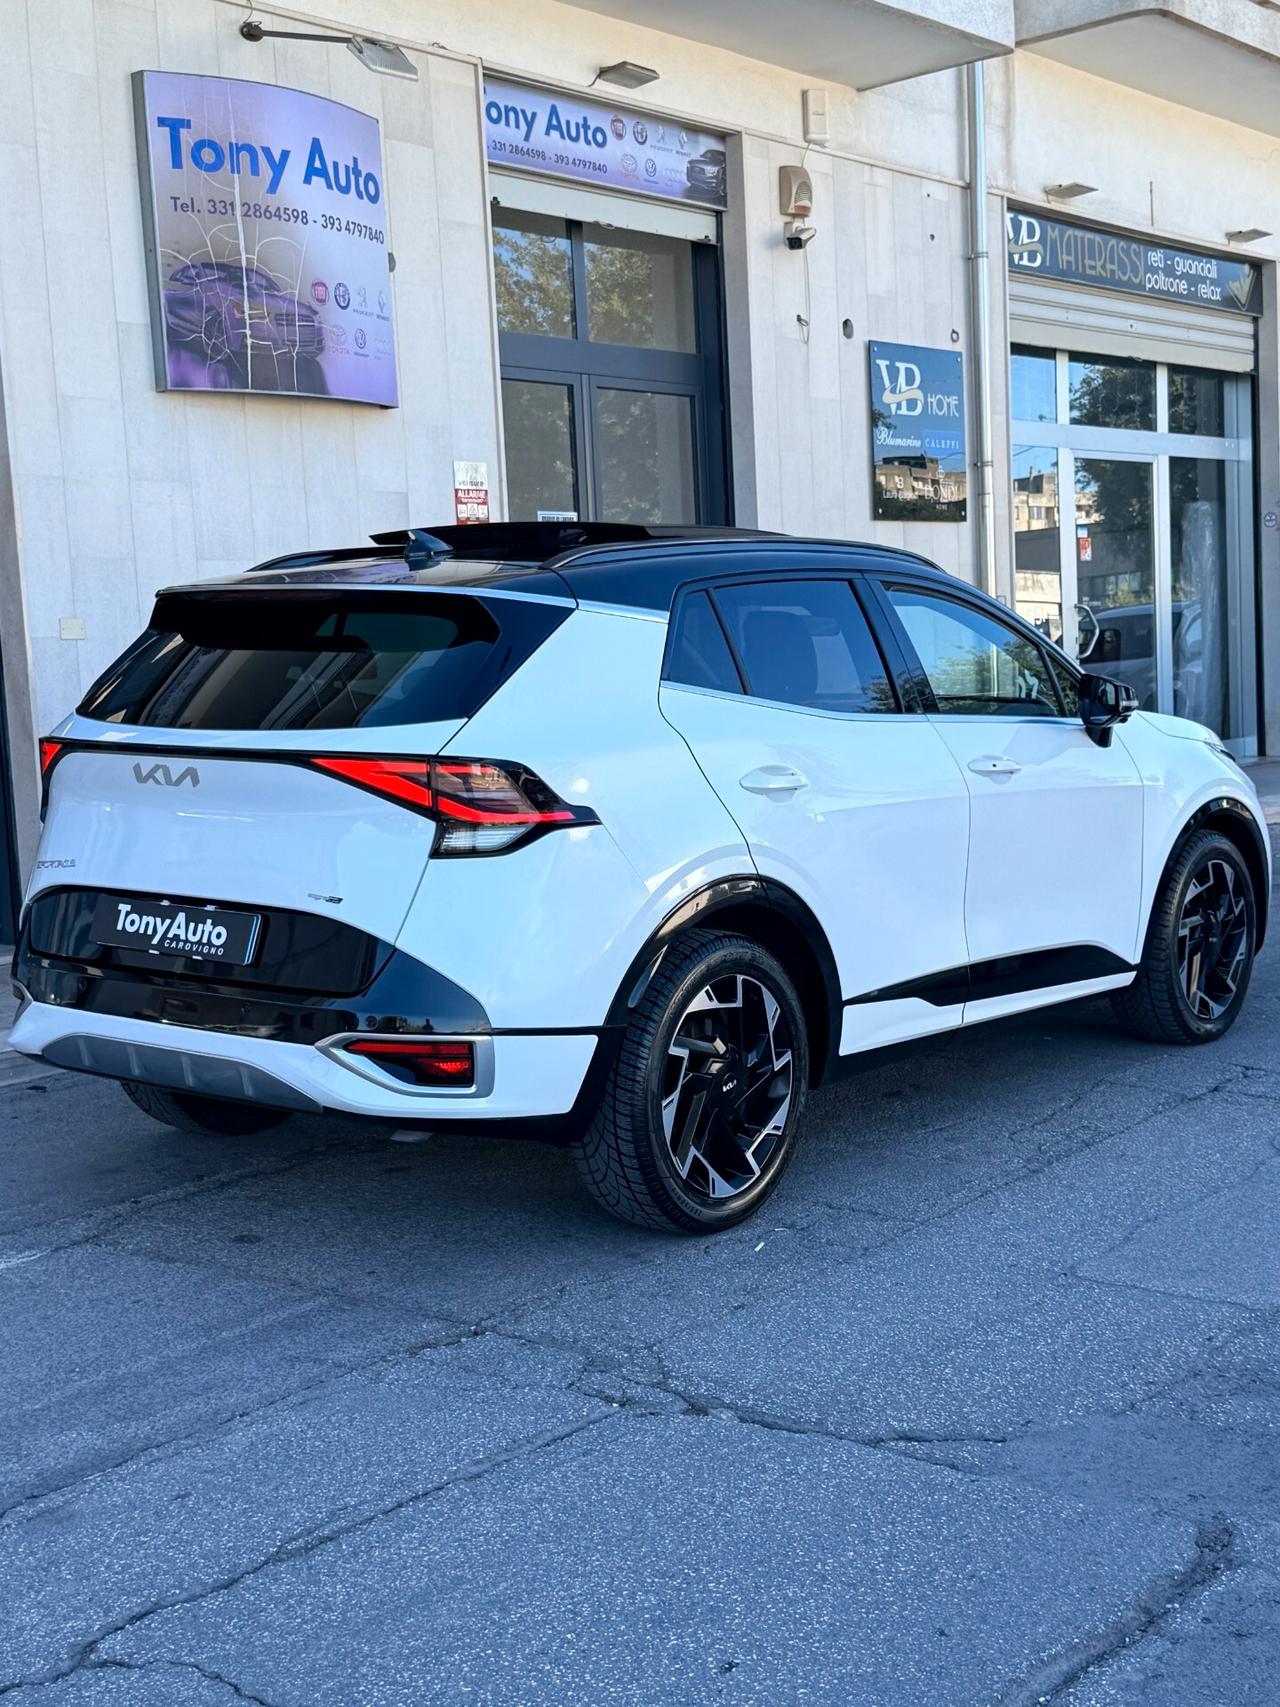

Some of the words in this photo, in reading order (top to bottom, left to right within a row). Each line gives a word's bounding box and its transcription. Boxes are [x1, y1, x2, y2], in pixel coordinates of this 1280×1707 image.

[485, 100, 537, 142] ony
[544, 103, 608, 149] Auto
[157, 116, 291, 194] Tony
[303, 137, 380, 205] Auto
[492, 140, 507, 153] 331
[509, 144, 546, 161] 2864598
[554, 153, 570, 166] 393
[571, 157, 608, 174] 4797840
[170, 196, 200, 215] Tel.
[207, 199, 236, 217] 331
[241, 201, 309, 226] 2864598
[321, 214, 343, 233] 393
[344, 222, 385, 245] 4797840
[1046, 224, 1146, 285] MATERASSI
[1147, 249, 1165, 267] reti
[1174, 257, 1218, 279] guanciali
[1145, 270, 1188, 295] poltrone
[1197, 280, 1222, 302] relax
[927, 391, 959, 418] HOME
[876, 427, 922, 449] Blumarine
[924, 437, 960, 450] CALEFFI
[115, 903, 227, 945] TonyAuto
[164, 940, 224, 956] CAROVIGNO
